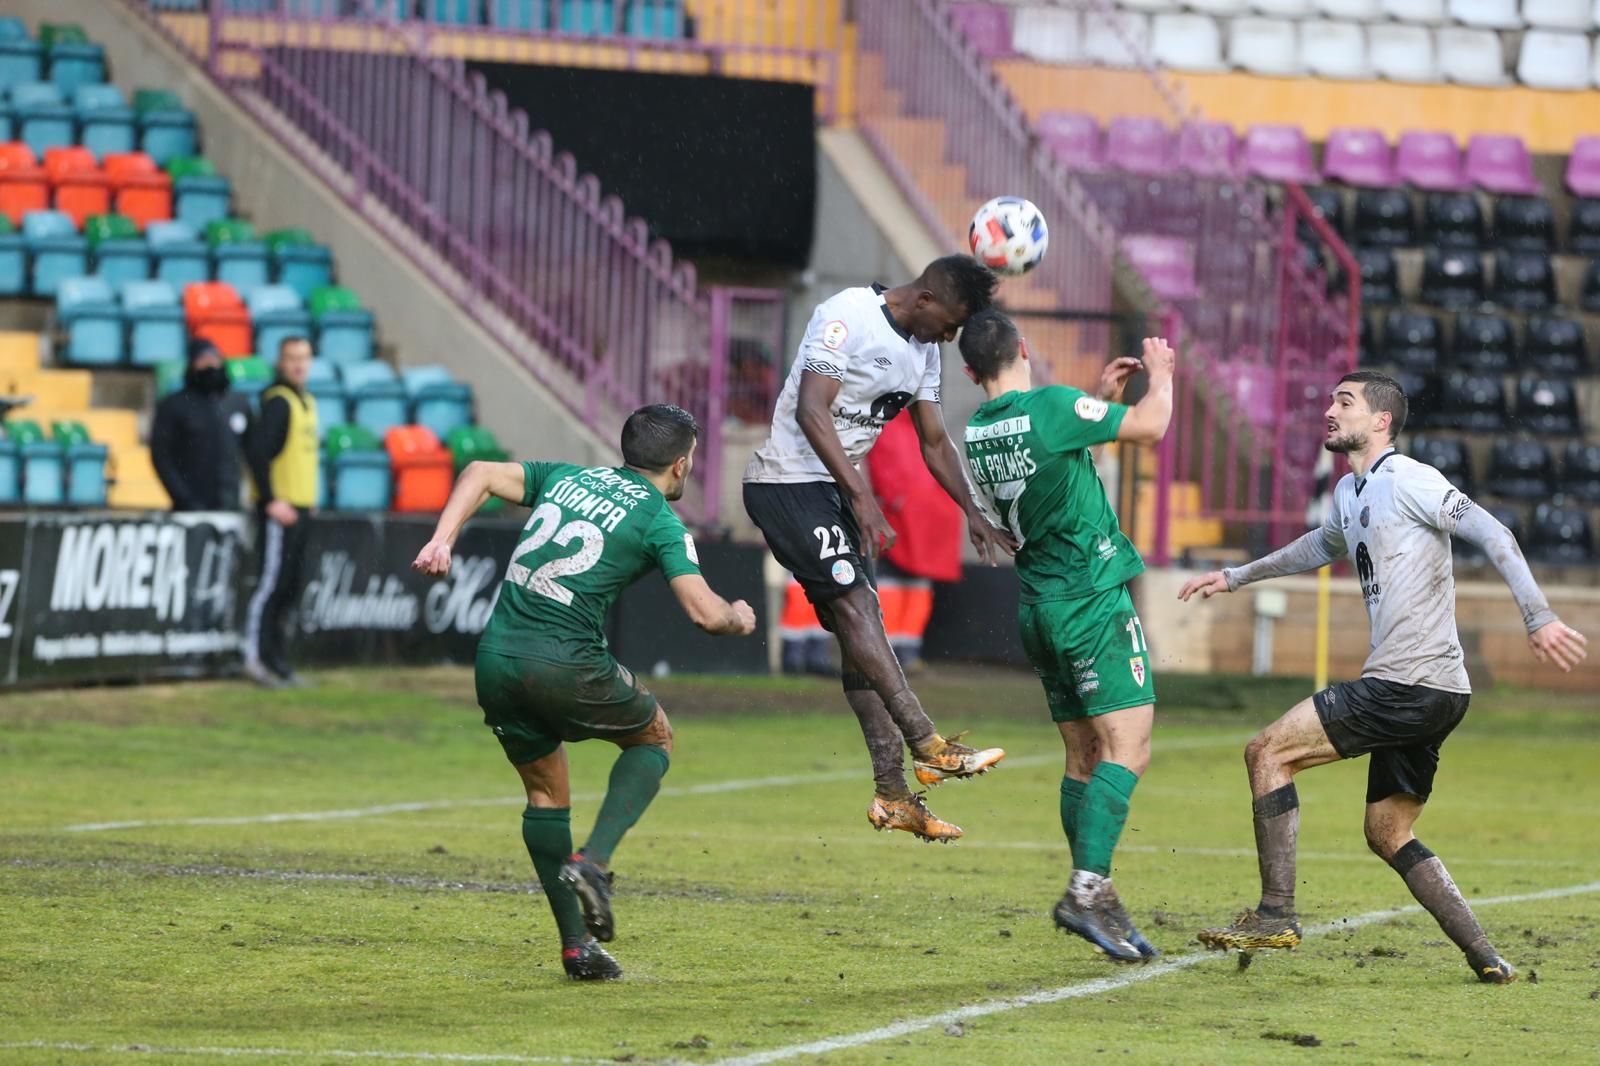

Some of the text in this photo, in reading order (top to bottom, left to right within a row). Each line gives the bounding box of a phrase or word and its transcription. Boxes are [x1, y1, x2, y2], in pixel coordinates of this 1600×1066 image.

[985, 444, 1037, 482] PALMÁS
[544, 480, 627, 533] JUAMPA
[504, 502, 604, 606] 22
[813, 525, 851, 560] 22
